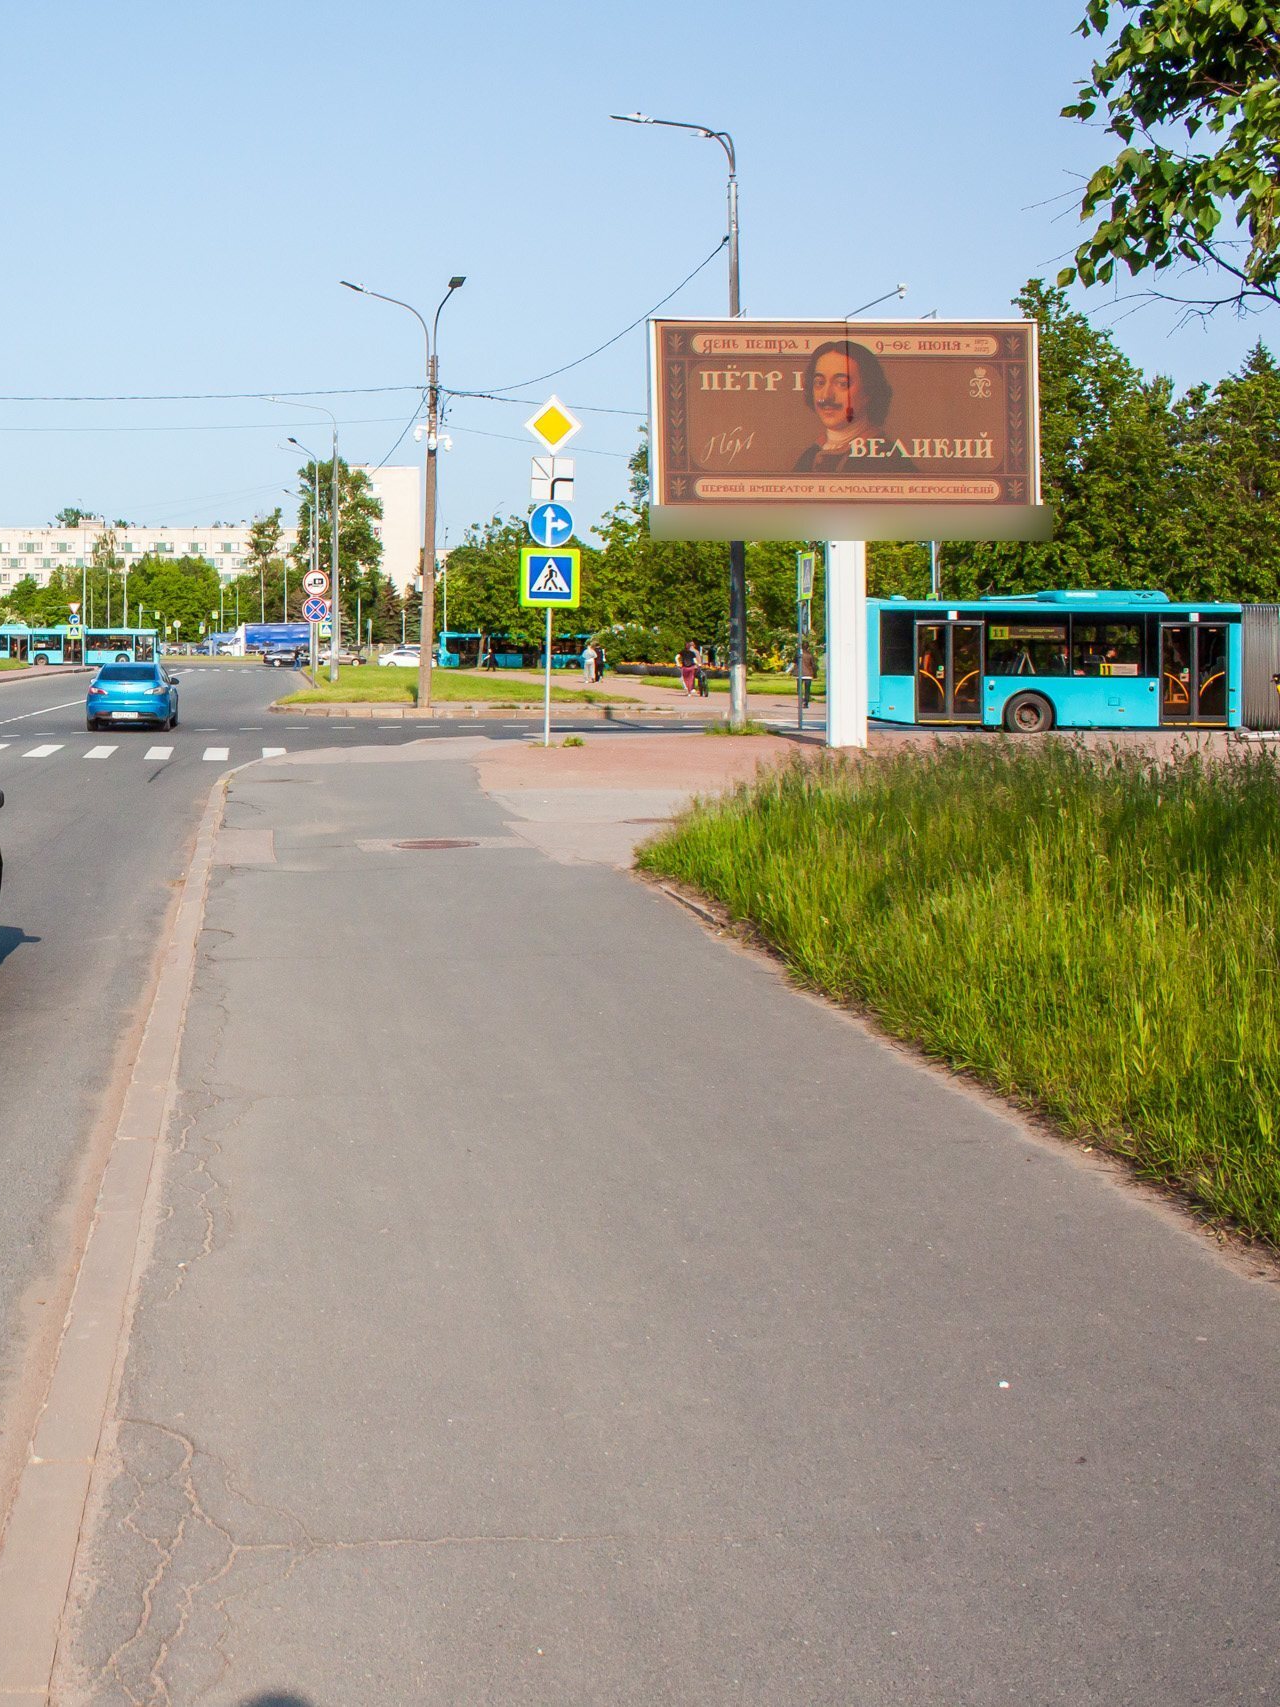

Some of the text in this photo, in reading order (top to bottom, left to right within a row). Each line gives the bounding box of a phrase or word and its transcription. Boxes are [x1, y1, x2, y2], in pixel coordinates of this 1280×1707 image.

[699, 364, 804, 391] ПЁТР I
[848, 431, 995, 459] ВЕЛИКИЙ
[701, 483, 745, 493] ПЕРВЫЙ
[749, 484, 814, 493] ИМПЕРАТОР
[829, 485, 904, 494] САМОДЕРЖЕЦ
[908, 485, 994, 494] ВСЕРОССИЙСКИЙ
[1102, 665, 1111, 676] 11
